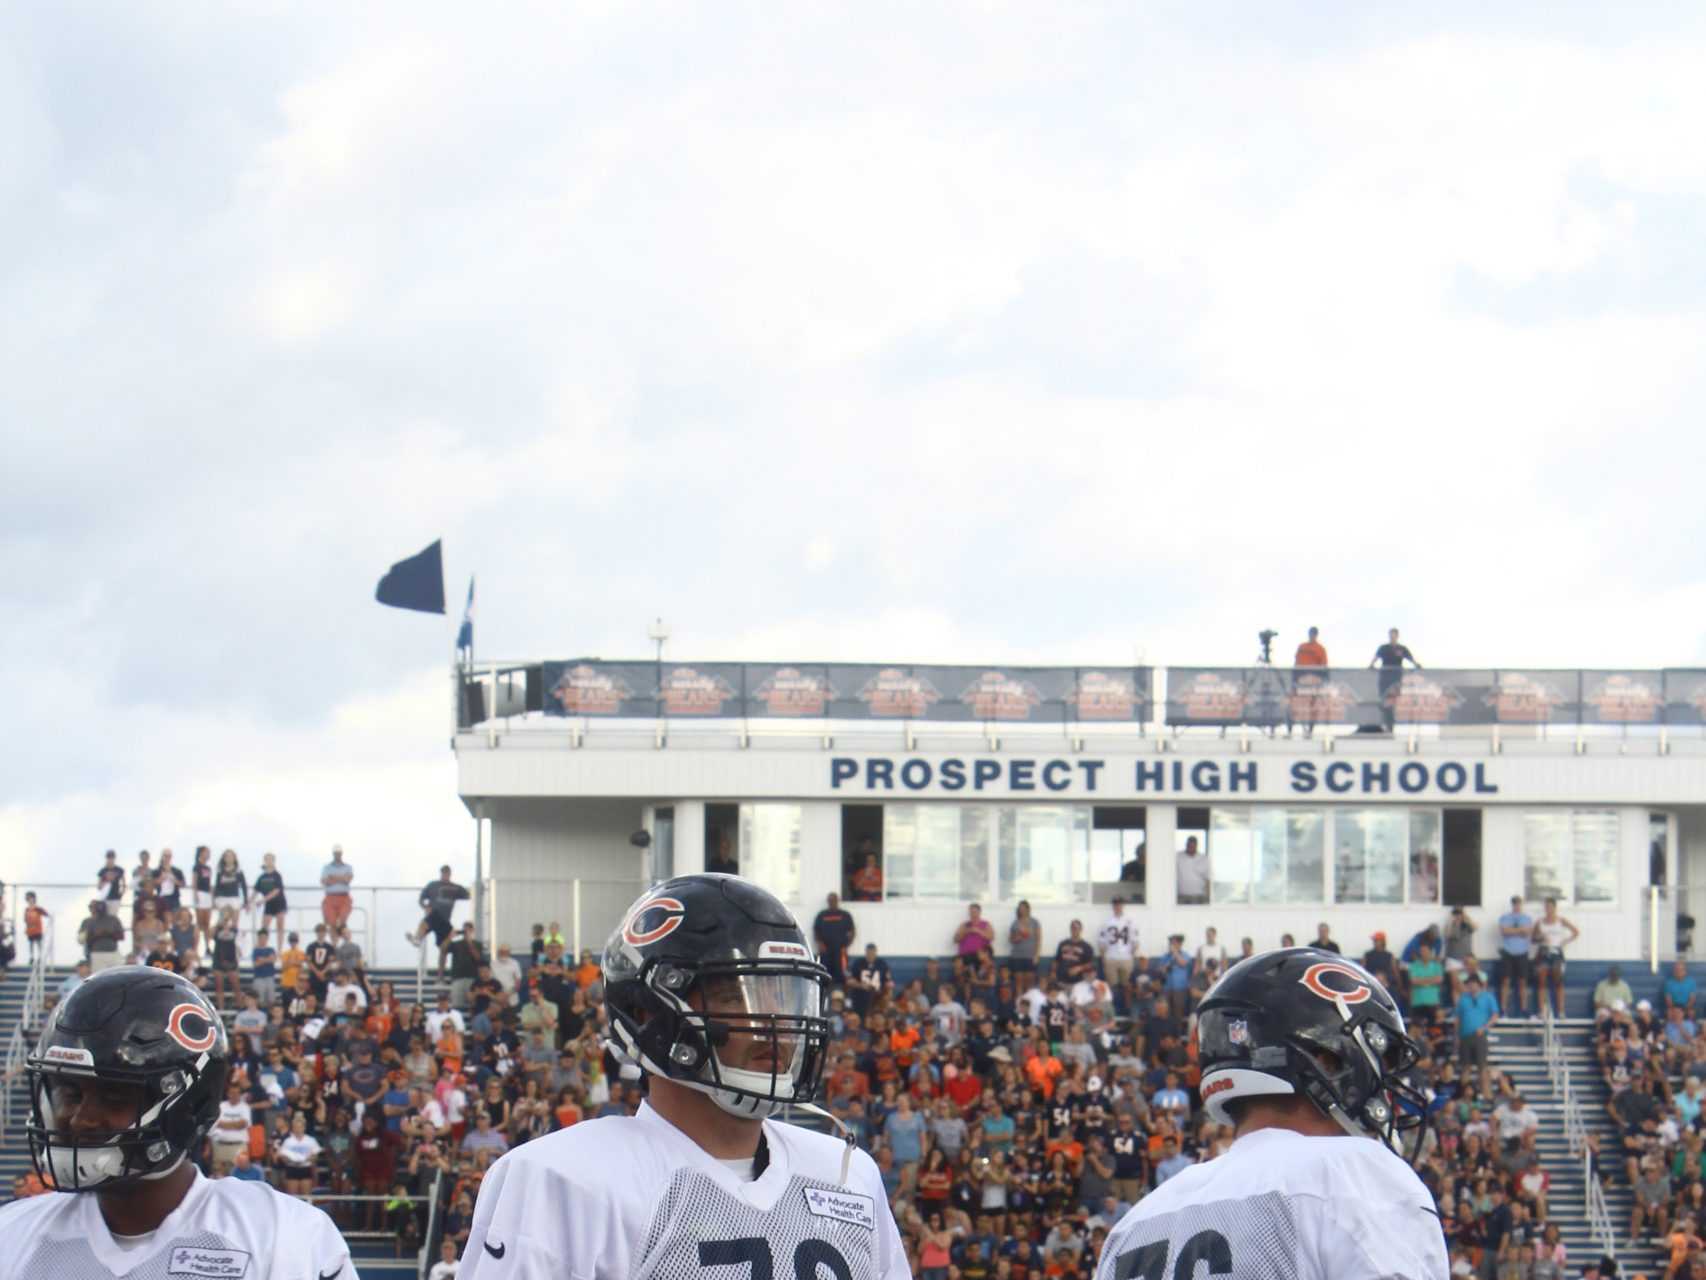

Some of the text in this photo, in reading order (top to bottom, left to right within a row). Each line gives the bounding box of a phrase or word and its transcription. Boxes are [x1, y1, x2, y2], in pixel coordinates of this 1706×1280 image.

[831, 758, 1500, 794] PROSPECT HIGH SCHOOL
[1107, 926, 1129, 944] 34
